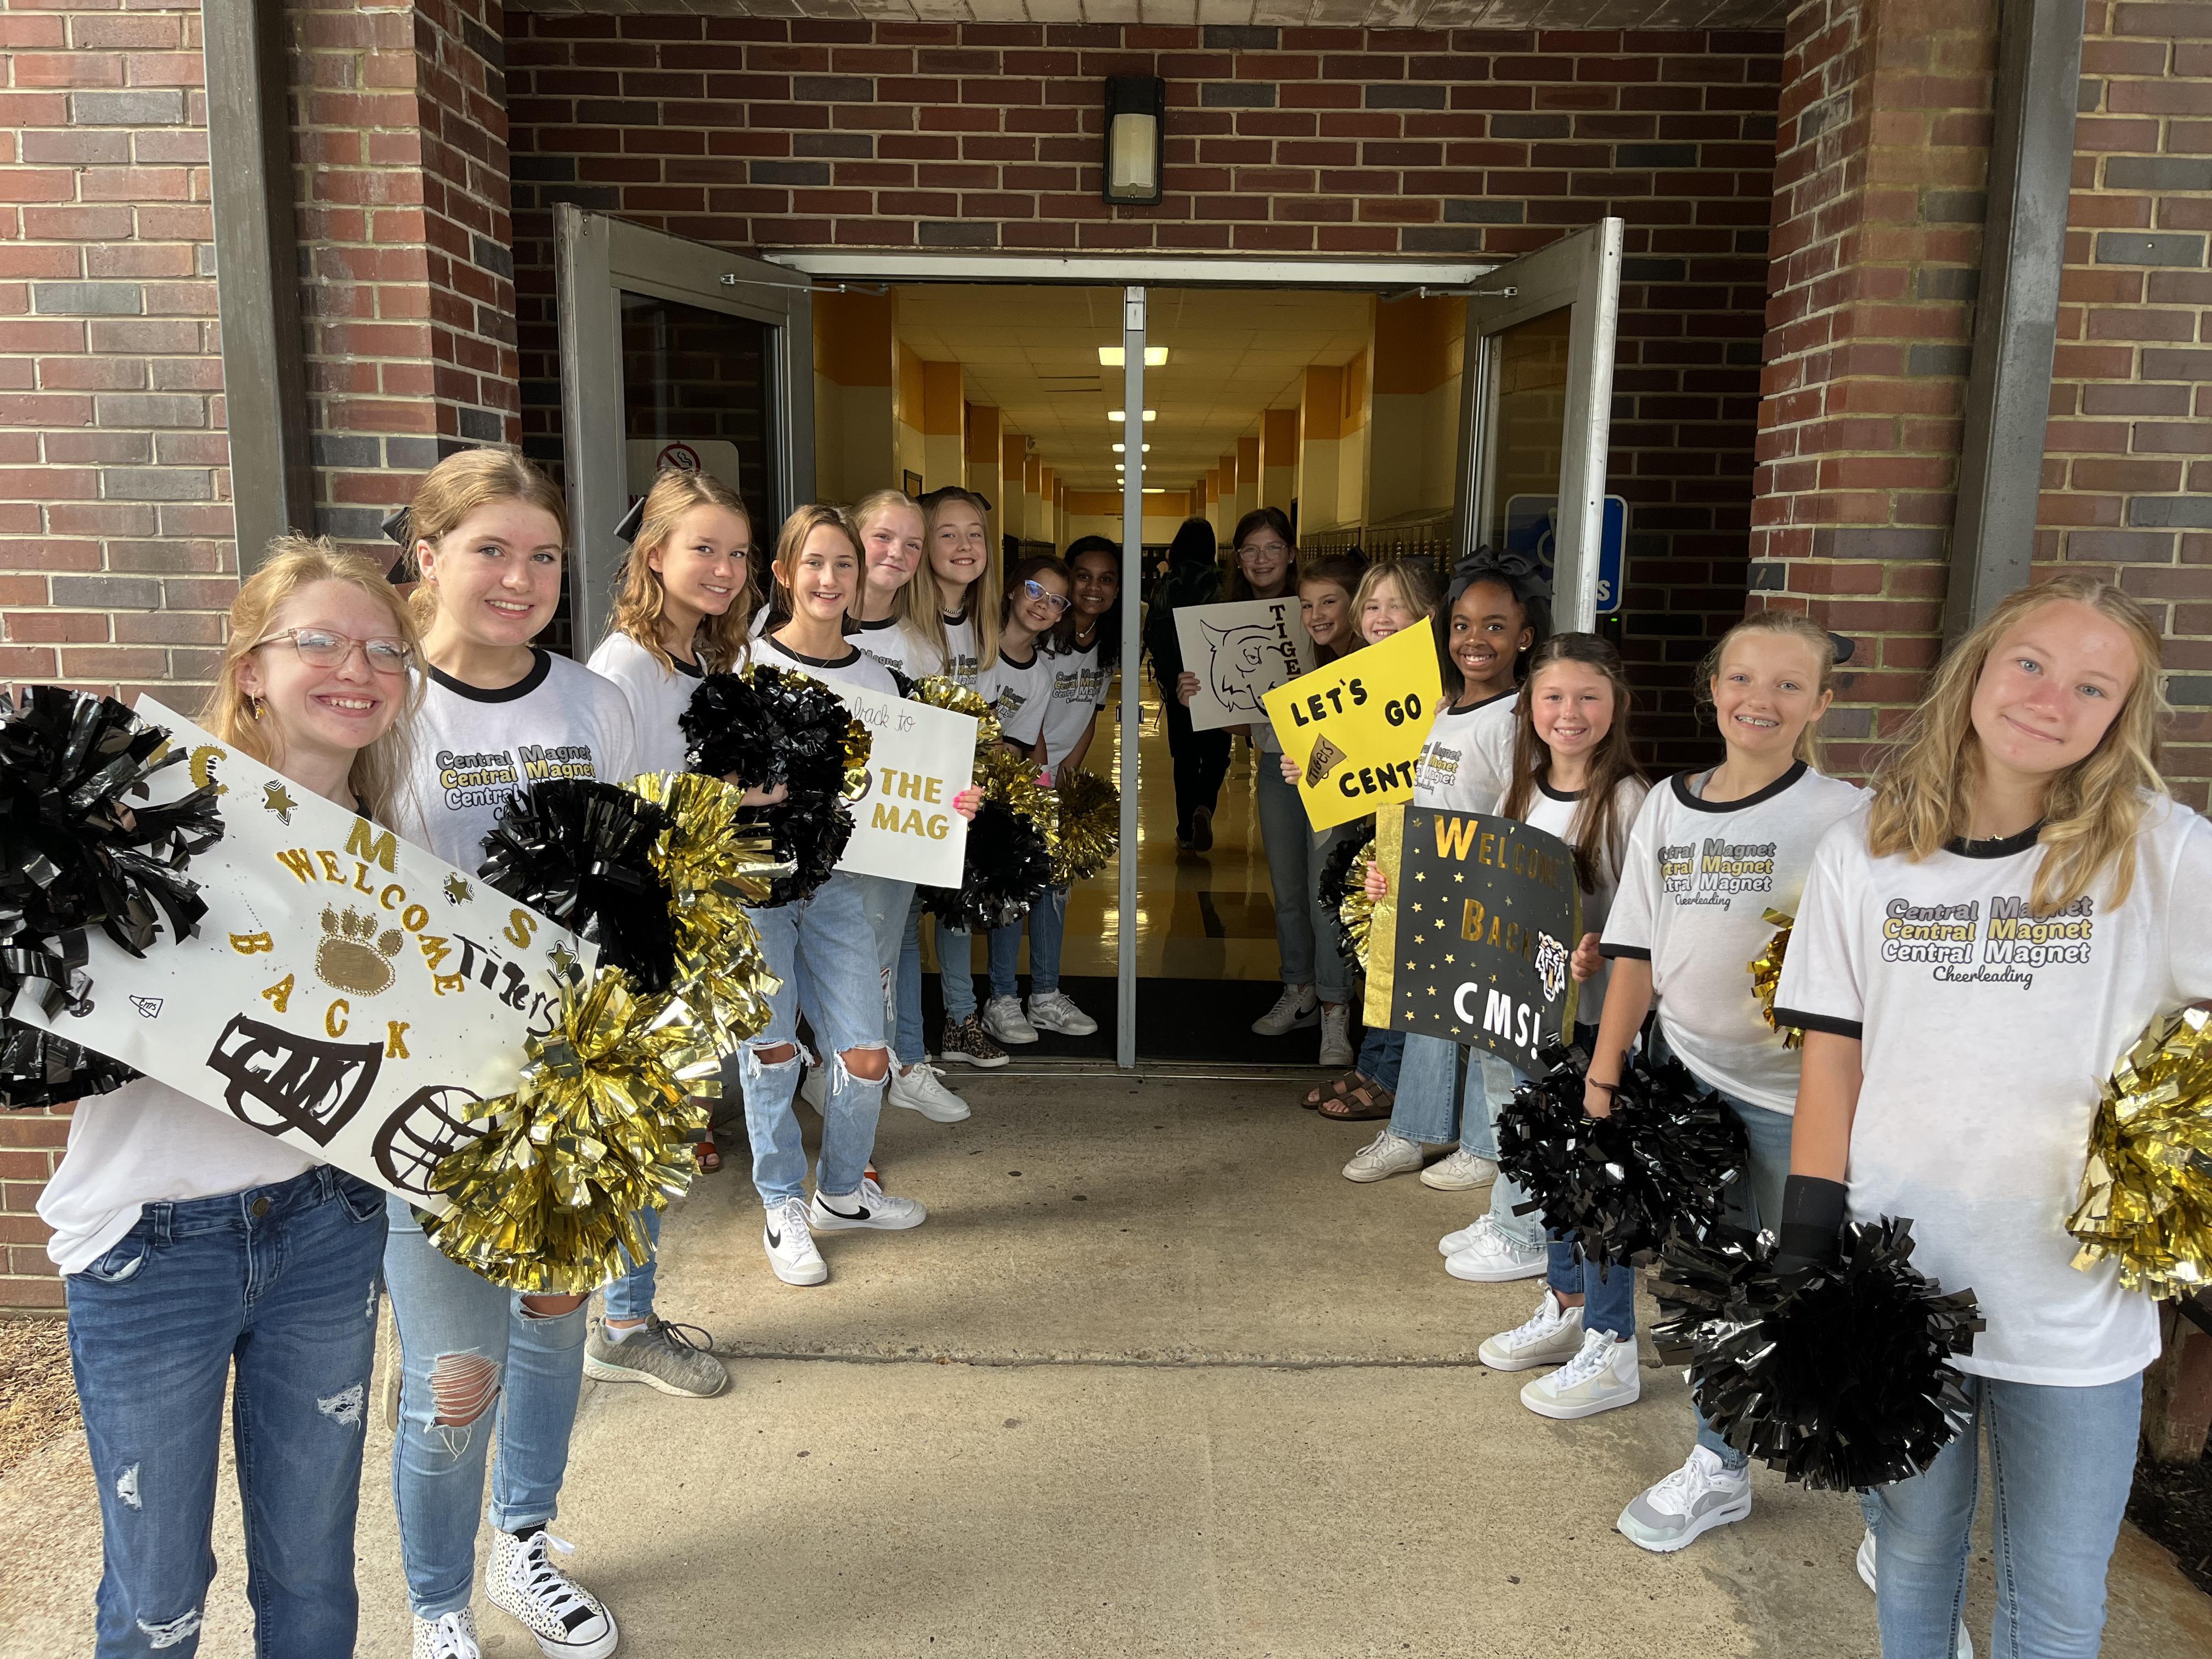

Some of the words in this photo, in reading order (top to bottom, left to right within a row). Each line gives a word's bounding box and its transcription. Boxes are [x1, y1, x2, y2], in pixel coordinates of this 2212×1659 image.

[1269, 604, 1301, 681] TIGE
[854, 696, 889, 728] back
[895, 708, 916, 732] to
[1290, 678, 1368, 727] LET'S
[1385, 693, 1421, 726] GO
[436, 751, 514, 770] Central
[518, 744, 592, 763] Magnet
[439, 766, 519, 789] Central
[523, 759, 596, 780] Magnet
[880, 767, 943, 804] THE
[1339, 758, 1419, 798] CENT
[871, 803, 950, 840] MAG
[1703, 838, 1776, 860] Magnet
[1701, 855, 1774, 877] Magnet
[1699, 872, 1772, 894] Magnet
[276, 847, 465, 997] WELCOME
[1886, 898, 1979, 921] Central
[1461, 898, 1532, 962] BACK
[1883, 918, 1976, 942] Central
[1987, 919, 2093, 945] Magnet
[1881, 939, 1973, 964] Central
[1984, 940, 2091, 968] Magnet
[1933, 964, 2033, 990] Cheerleading
[1453, 982, 1541, 1060] CMS!
